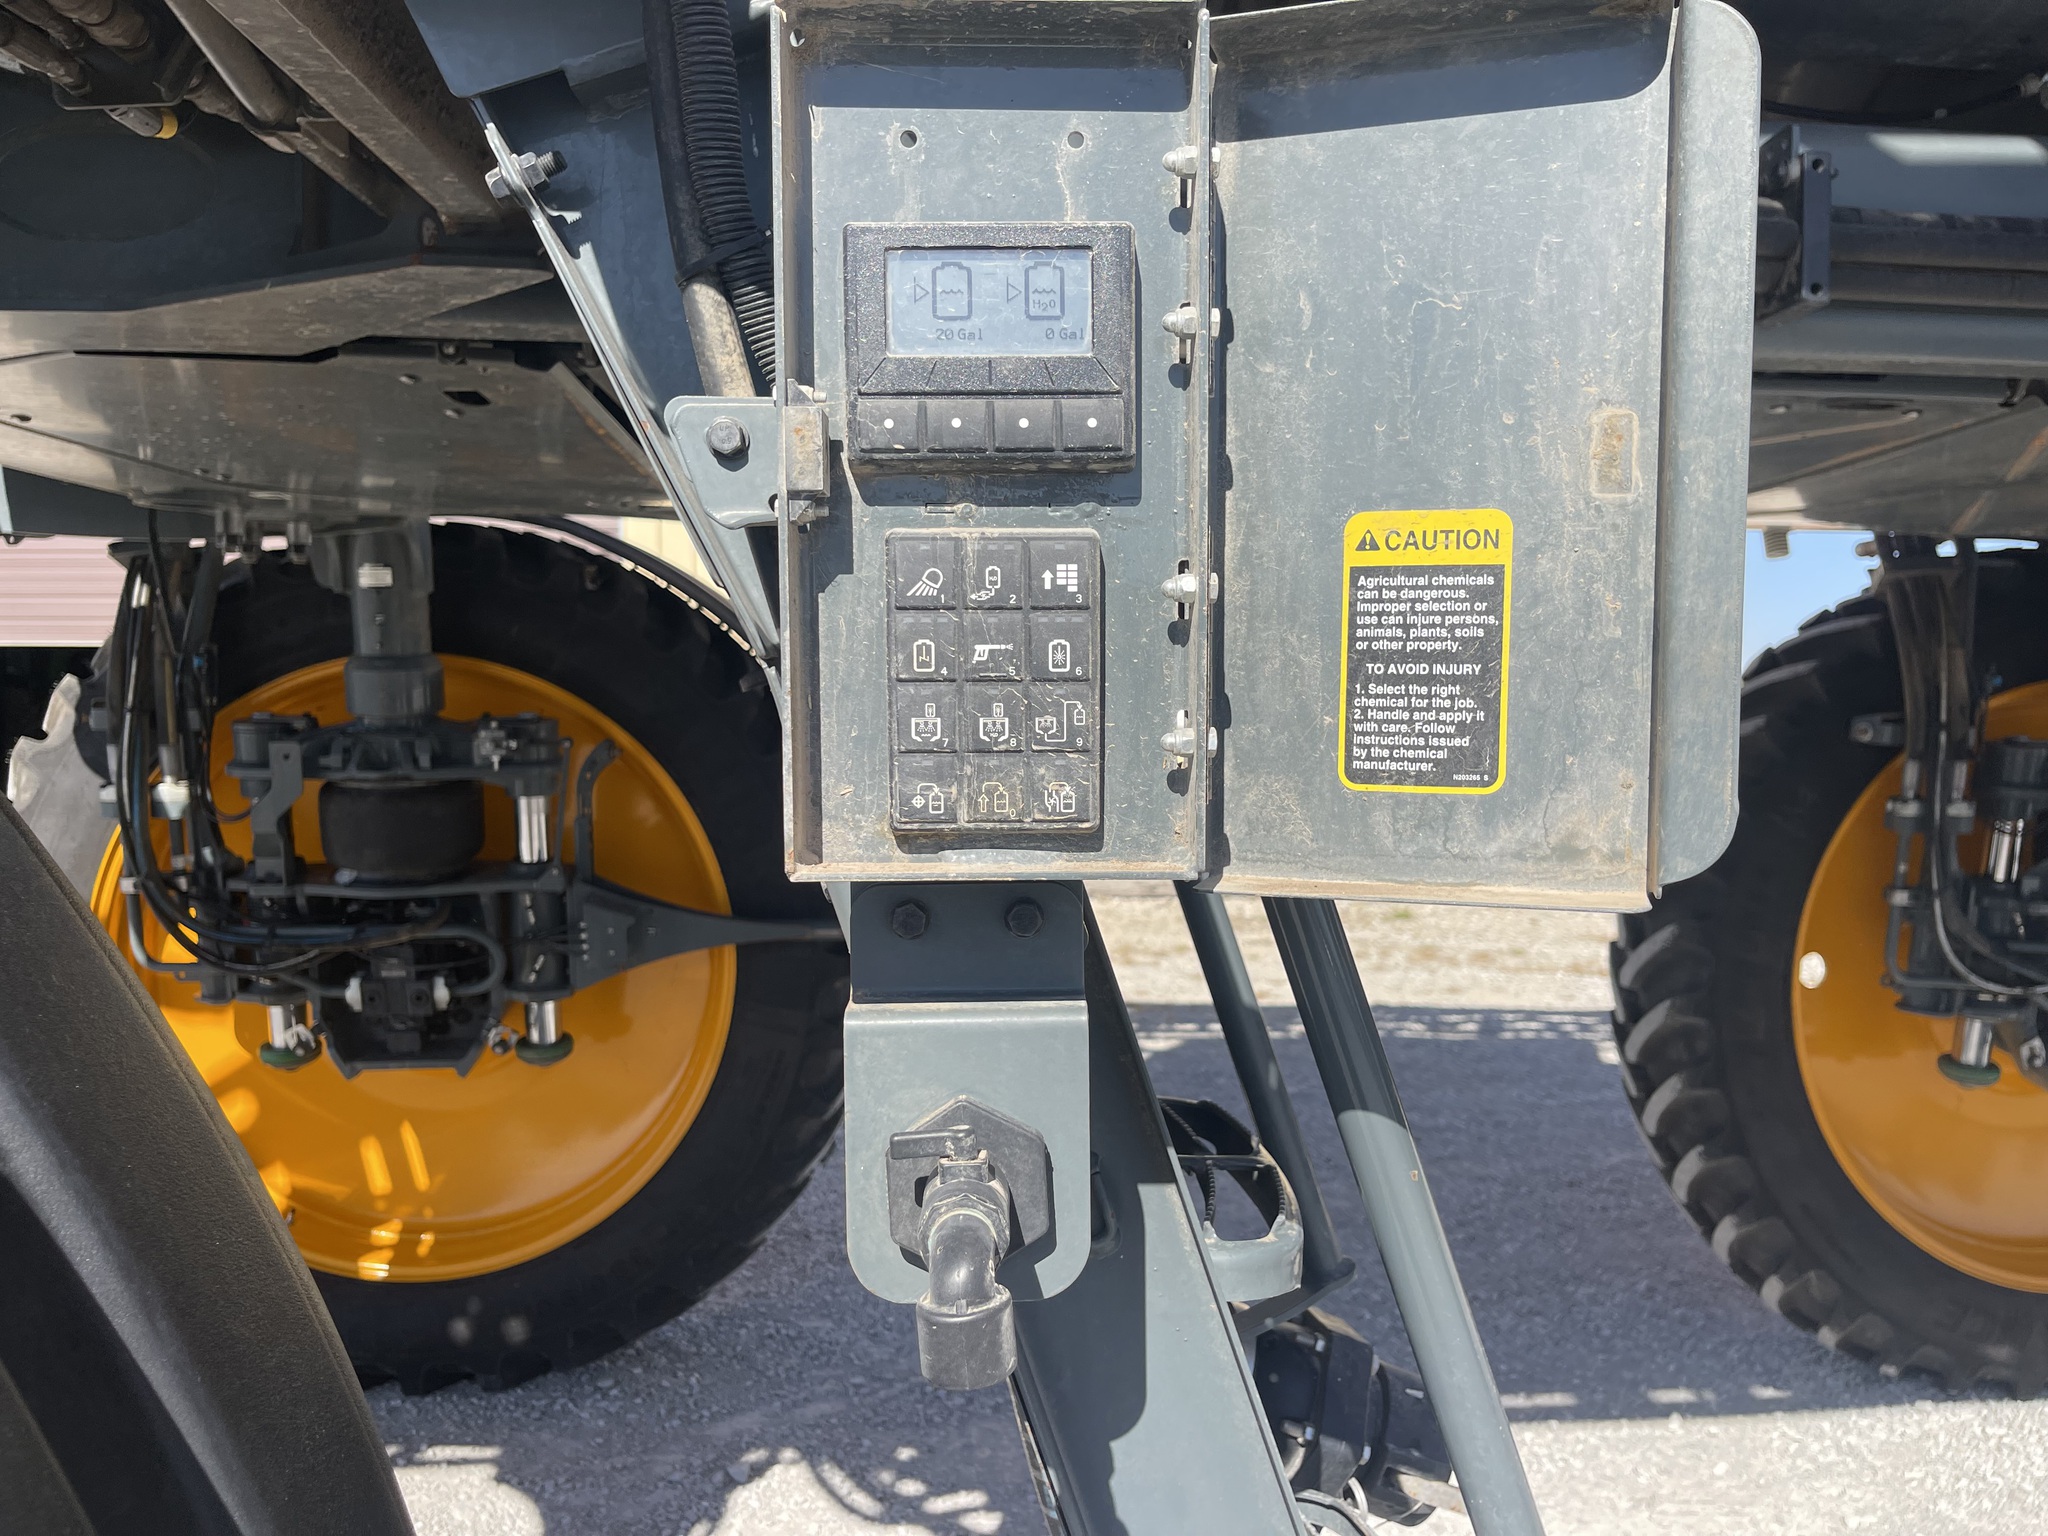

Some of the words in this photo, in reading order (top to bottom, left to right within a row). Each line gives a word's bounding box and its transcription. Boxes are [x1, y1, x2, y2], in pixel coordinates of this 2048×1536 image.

[936, 328, 954, 340] 20
[958, 328, 983, 341] Gal
[1045, 328, 1055, 340] 0
[1059, 328, 1084, 341] Gal
[1384, 529, 1499, 551] CAUTION
[1357, 575, 1428, 588] Agricultural
[1432, 574, 1494, 586] chemicals
[1009, 594, 1016, 604] 2
[1075, 594, 1083, 604] 3
[1357, 590, 1379, 599] can
[1382, 588, 1397, 599] be
[1400, 588, 1470, 600] dangerous.
[1356, 601, 1412, 614] Improper
[1414, 600, 1471, 612] selection
[1473, 602, 1488, 612] or
[1356, 615, 1378, 625] use
[1381, 615, 1403, 625] can
[1406, 613, 1442, 626] injure
[1444, 614, 1499, 626] persons,
[1355, 626, 1407, 638] animals,
[1409, 627, 1451, 639] plants,
[1454, 626, 1485, 638] soils
[1355, 641, 1369, 650] or
[1371, 640, 1404, 650] other
[1406, 641, 1462, 652] property.
[940, 666, 948, 676] 4
[1008, 666, 1016, 676] 5
[1075, 666, 1083, 676] 6
[1366, 664, 1385, 675] TO
[1387, 664, 1430, 675] AVOID
[1432, 664, 1482, 675] INJURY
[1355, 684, 1365, 695] 1.
[1368, 683, 1406, 695] Select
[1408, 684, 1429, 695] the
[1431, 684, 1461, 697] right
[1354, 696, 1408, 707] chemical
[1410, 697, 1429, 708] for
[1431, 697, 1452, 708] the
[1453, 697, 1478, 710] job.
[1353, 709, 1364, 720] 2.
[1367, 709, 1410, 720] Handle
[1412, 710, 1436, 721] and
[1438, 710, 1474, 723] apply
[1476, 710, 1485, 721] it
[1353, 721, 1379, 732] with
[1381, 723, 1411, 733] care.
[1415, 722, 1456, 733] Follow
[941, 737, 949, 747] 7
[1009, 737, 1017, 747] 8
[1076, 737, 1084, 747] 9
[1353, 733, 1425, 746] instructions
[1428, 735, 1470, 747] issued
[1352, 746, 1368, 759] by
[1370, 747, 1390, 758] the
[1392, 747, 1448, 759] chemical
[1352, 759, 1437, 771] manufacturer.
[1009, 808, 1017, 818] 0
